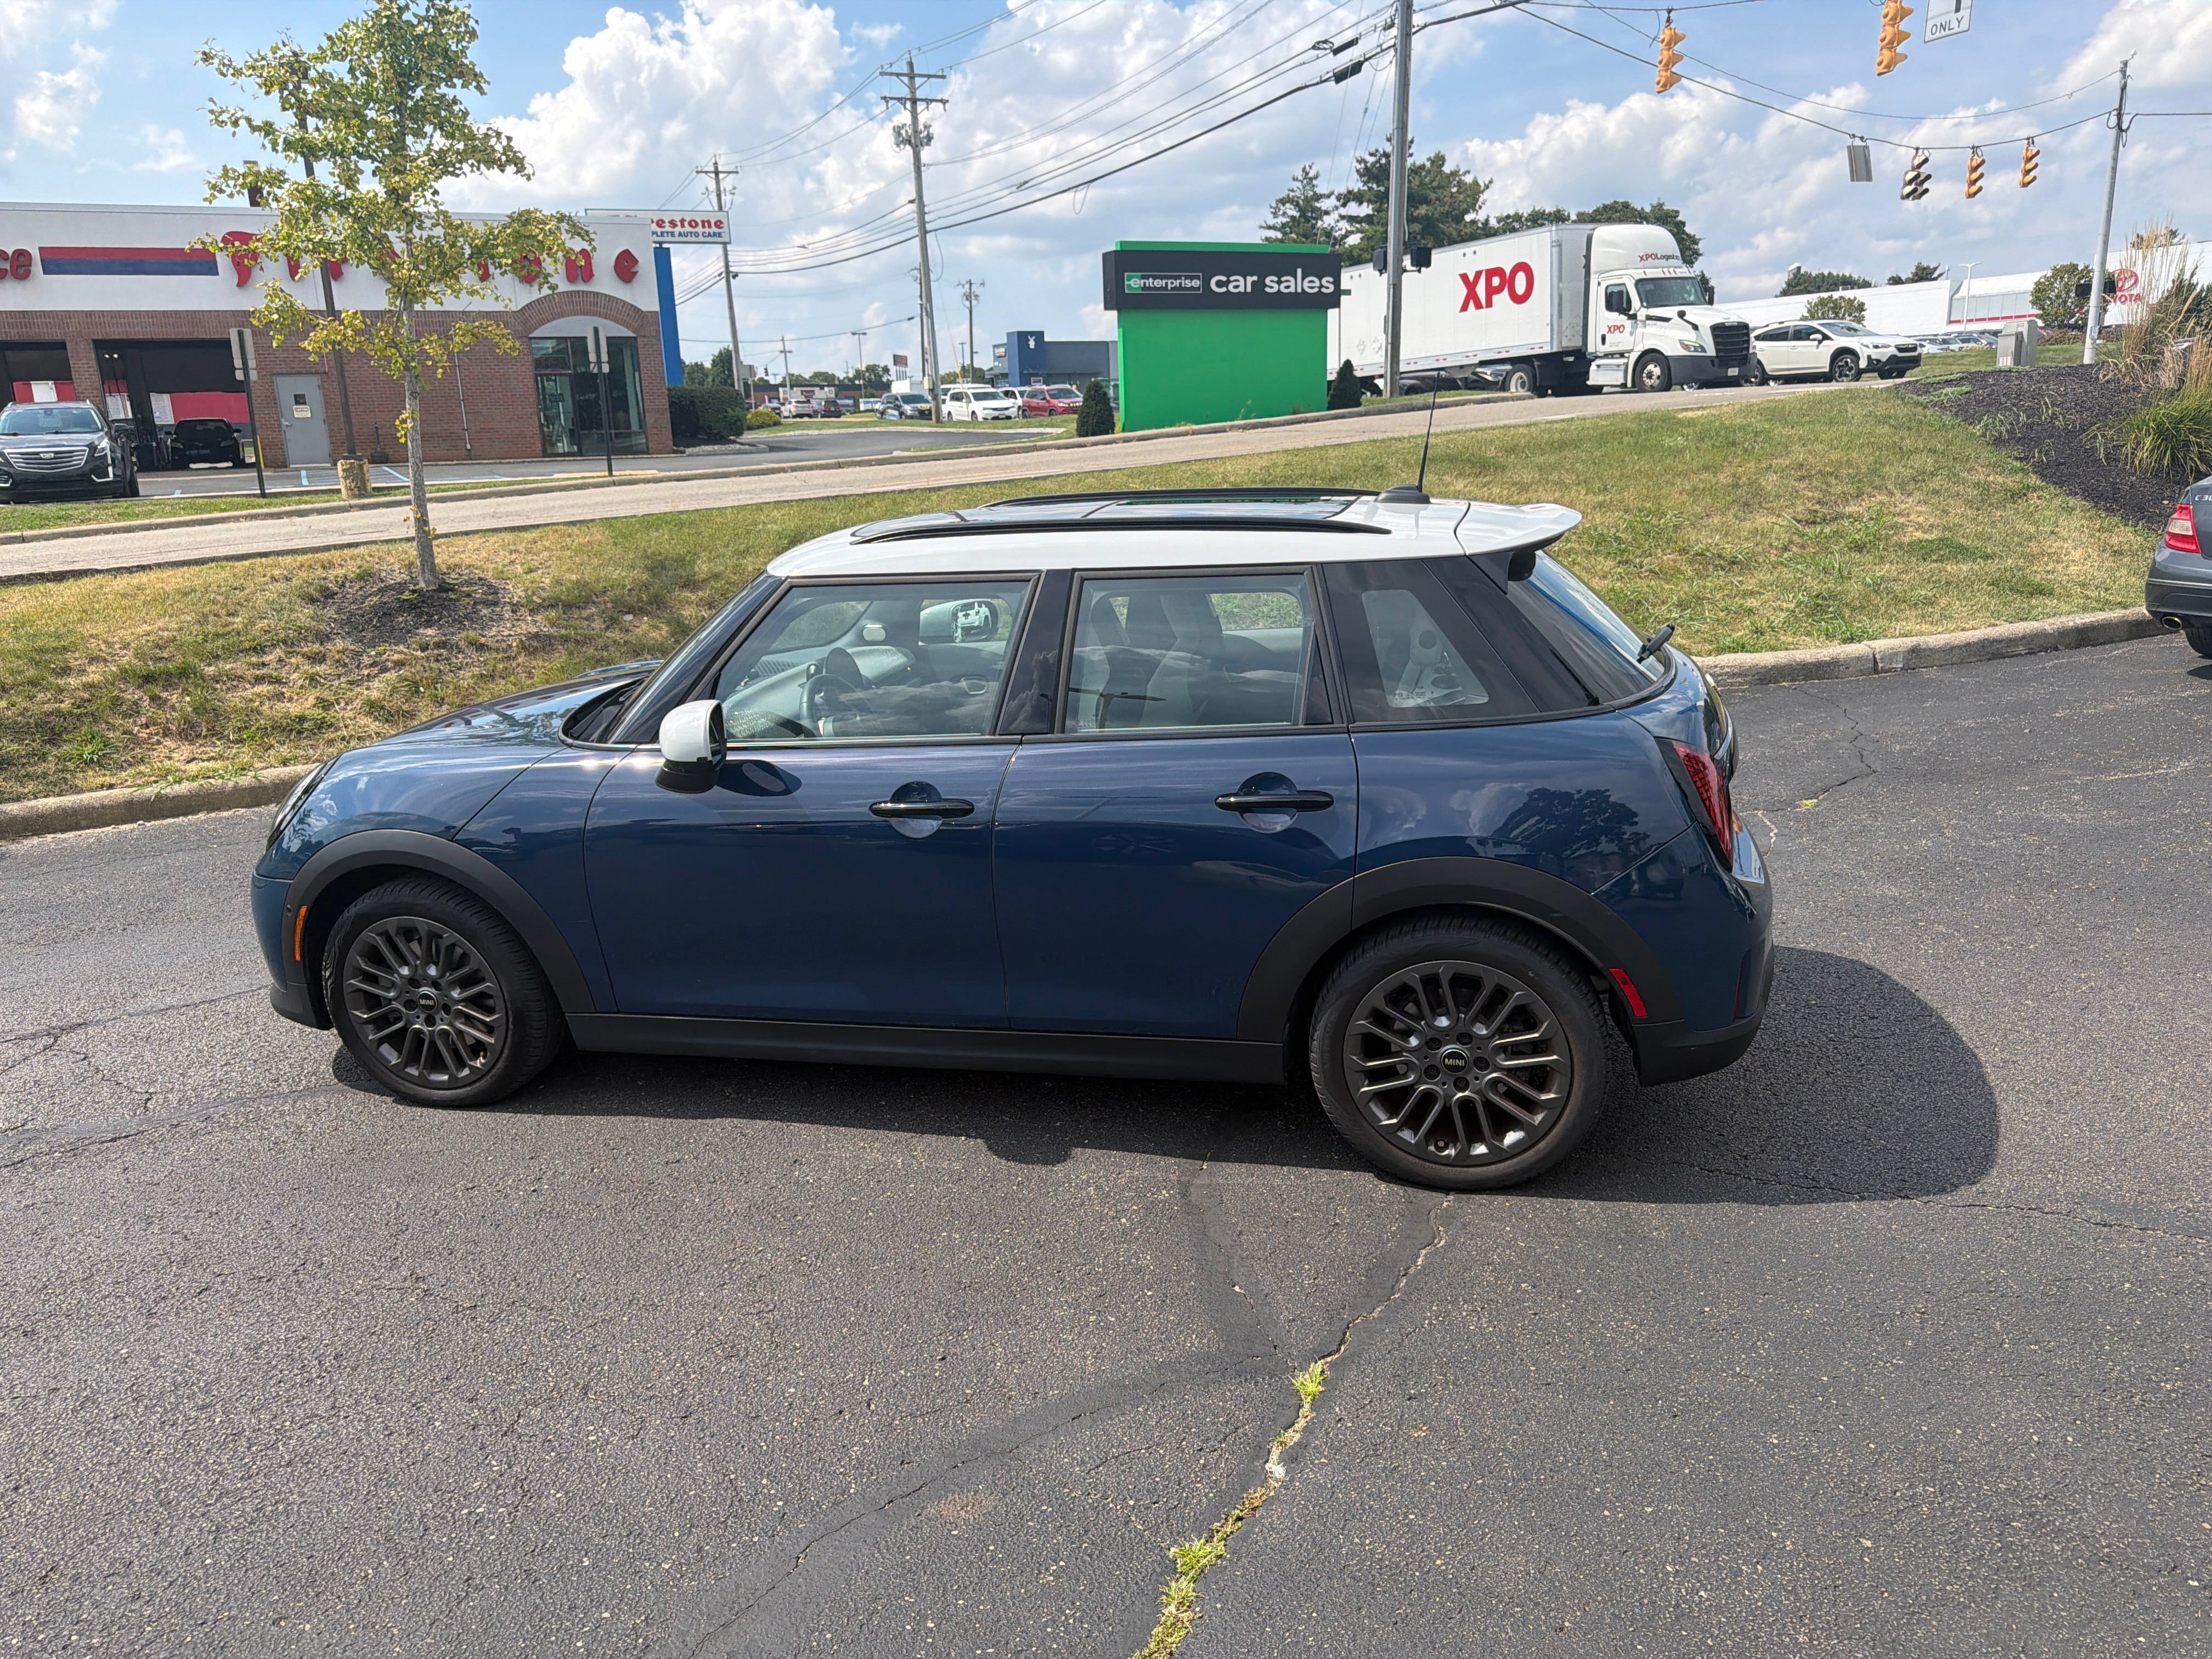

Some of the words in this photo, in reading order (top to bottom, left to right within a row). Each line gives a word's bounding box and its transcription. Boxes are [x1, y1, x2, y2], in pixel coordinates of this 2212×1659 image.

[1930, 15, 1964, 36] ONLY
[1128, 276, 1200, 290] enterprise
[1210, 275, 1258, 293] car
[1264, 268, 1335, 294] sales
[1458, 261, 1534, 313] XPO
[1606, 324, 1626, 334] XPO
[1444, 1058, 1465, 1066] MINI
